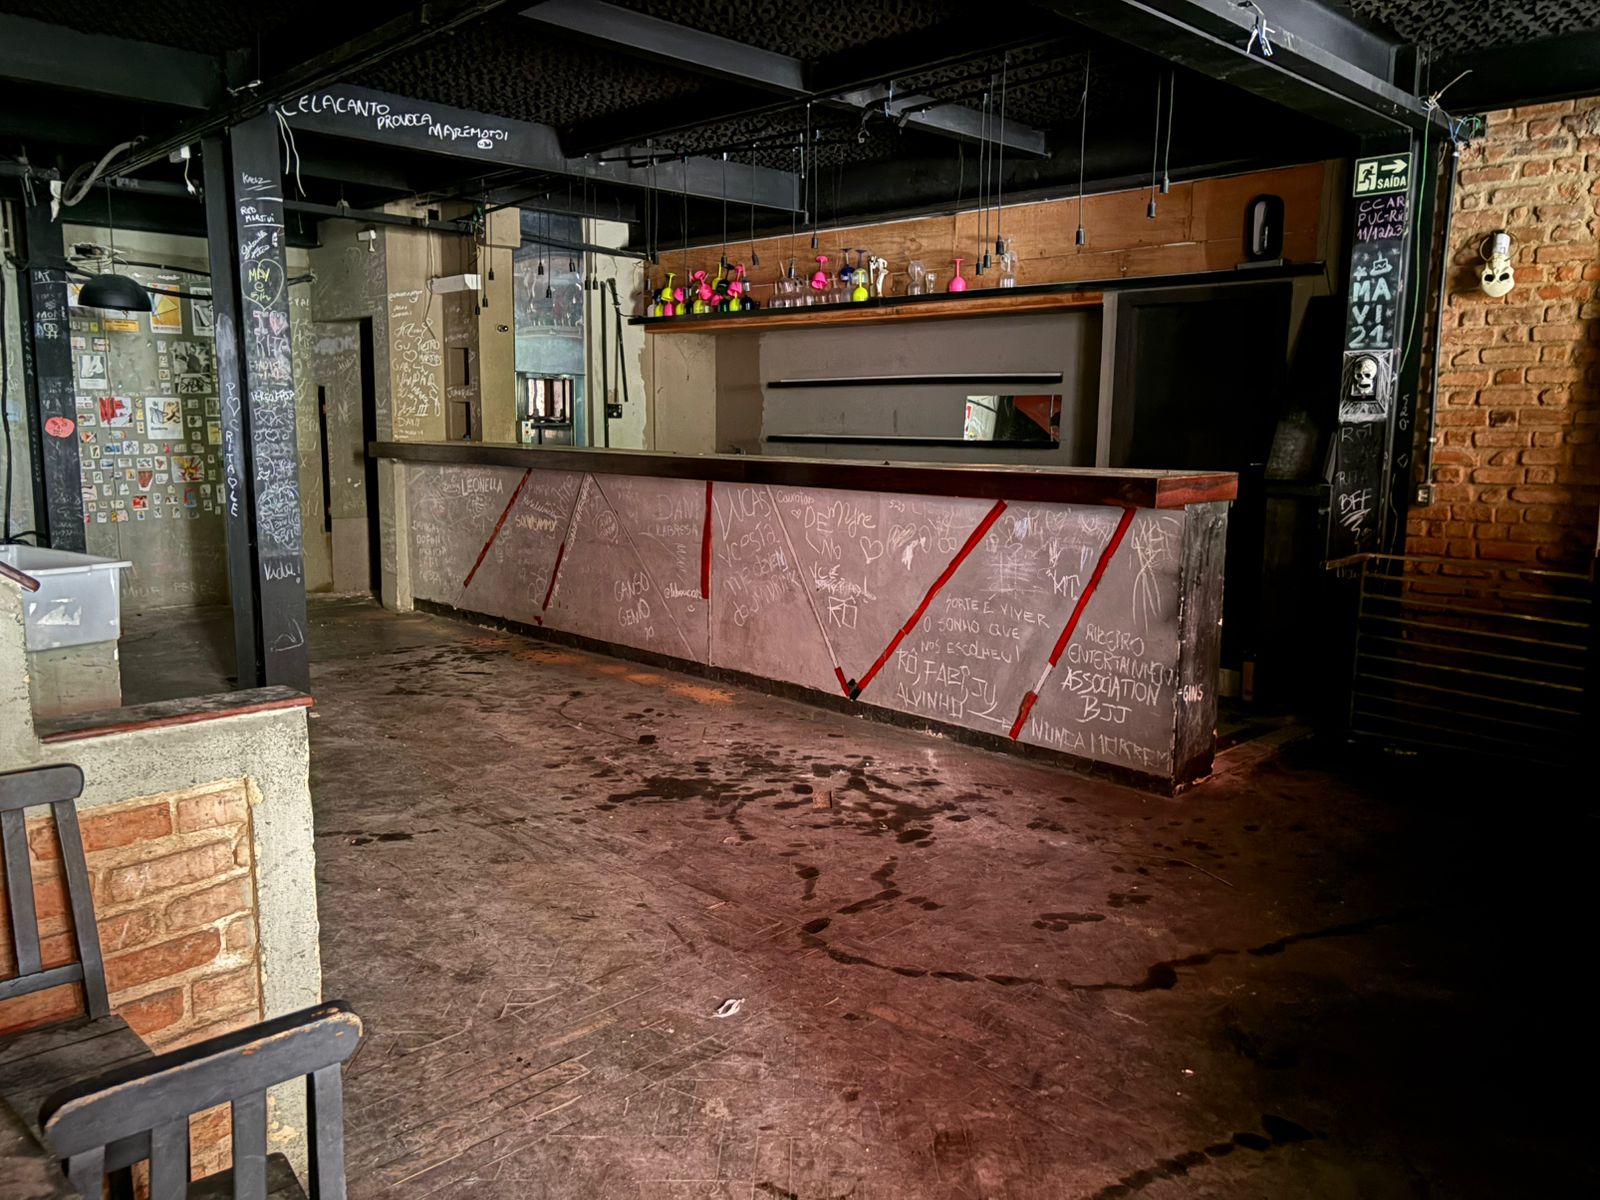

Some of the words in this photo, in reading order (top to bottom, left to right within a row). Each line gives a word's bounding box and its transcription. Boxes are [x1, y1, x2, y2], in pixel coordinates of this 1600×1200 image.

[377, 113, 432, 130] PROVOCA
[1377, 175, 1407, 190] SAÍDA
[1348, 324, 1389, 348] 21
[938, 617, 980, 634] SONHO
[1075, 694, 1133, 724] BJJ
[1031, 716, 1086, 750] NUNCA
